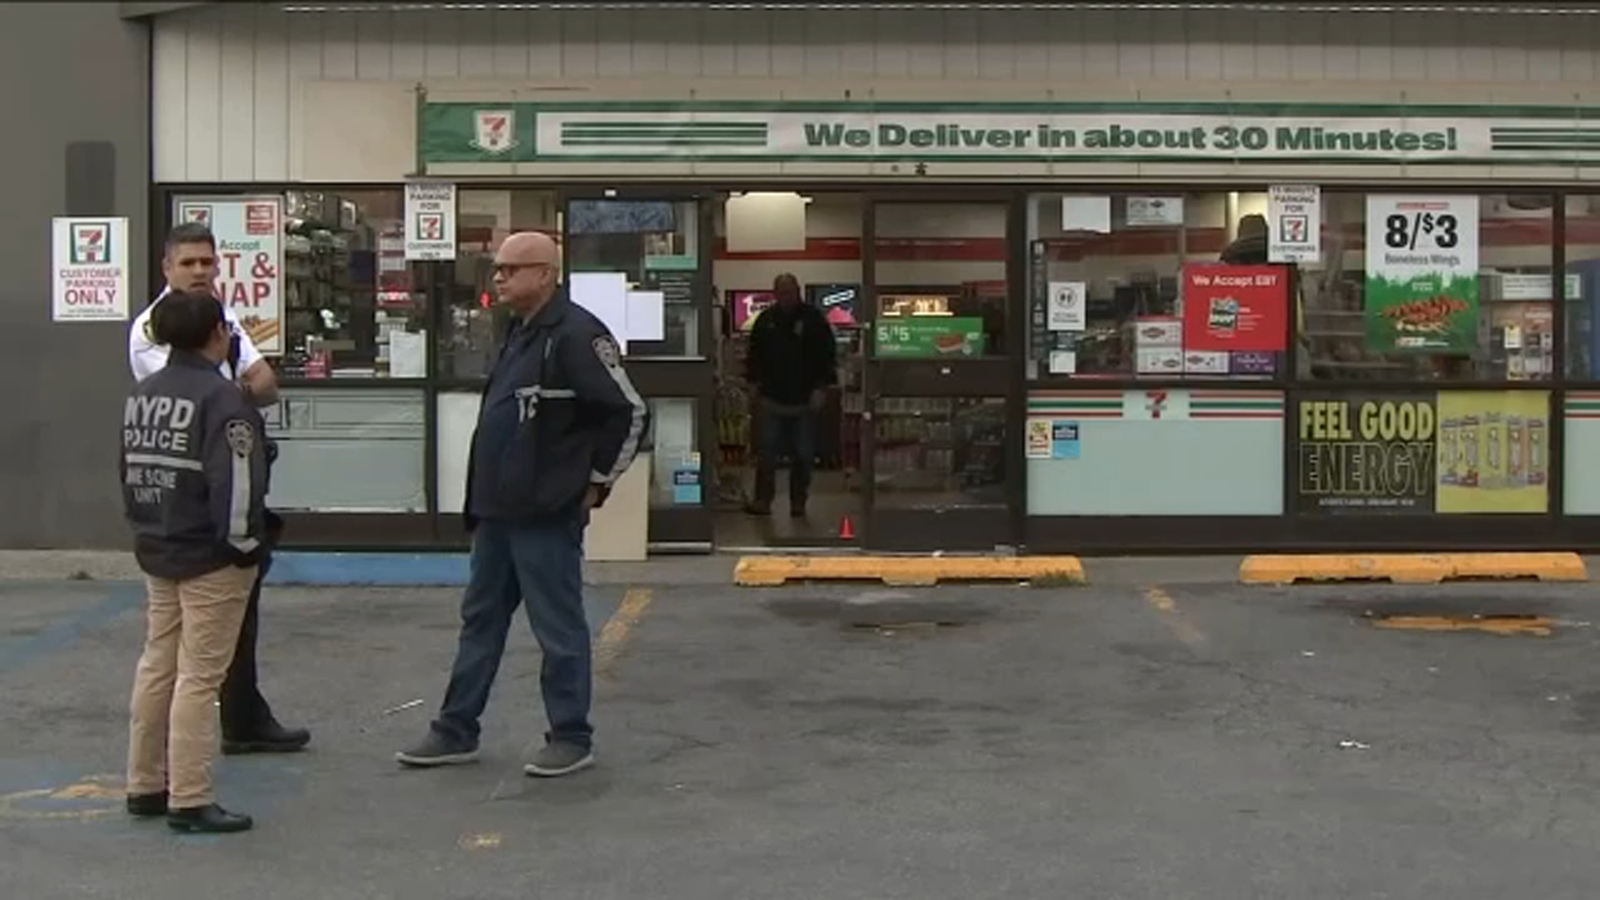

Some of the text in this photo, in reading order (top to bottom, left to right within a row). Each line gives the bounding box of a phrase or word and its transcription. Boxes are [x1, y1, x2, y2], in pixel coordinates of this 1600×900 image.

[804, 123, 1457, 151] We Deliver in about 30 Minutes!
[420, 202, 440, 210] FOR
[1274, 195, 1315, 203] PARKING
[1284, 204, 1304, 212] FOR
[1385, 212, 1459, 251] 8/$3
[219, 239, 261, 252] Accept
[251, 251, 276, 279] &
[1385, 253, 1428, 265] Boneless
[59, 268, 122, 278] CUSTOMER
[65, 279, 116, 288] PARKING
[1192, 274, 1210, 286] We
[1212, 274, 1253, 288] Accept
[65, 289, 116, 305] ONLY
[212, 282, 271, 308] NAP
[124, 396, 195, 429] NYPD
[1299, 401, 1435, 441] FEEL GOOD
[1299, 442, 1434, 496] ENERGY
